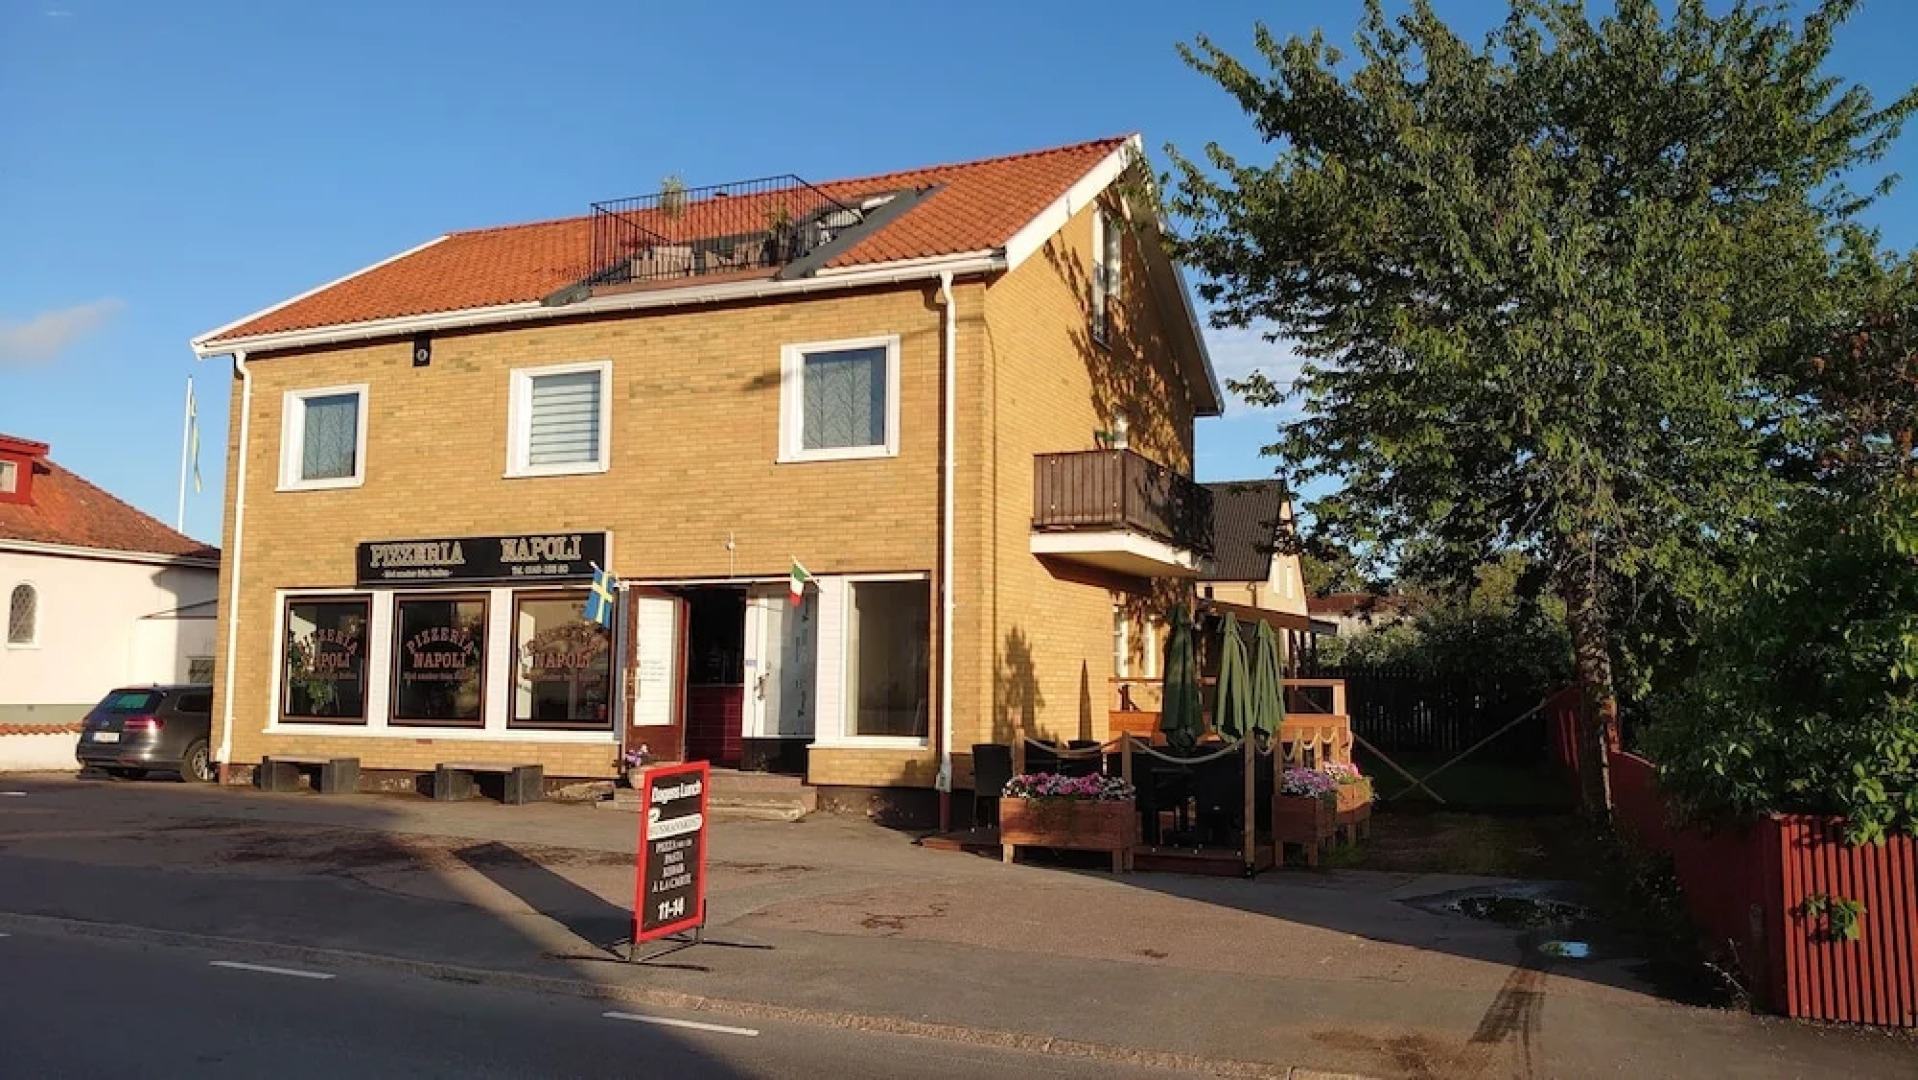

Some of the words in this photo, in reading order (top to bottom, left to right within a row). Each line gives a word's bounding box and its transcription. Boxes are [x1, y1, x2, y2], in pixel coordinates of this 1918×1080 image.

[370, 541, 464, 567] PIZZERIA
[500, 535, 582, 562] NAPOLI
[405, 626, 475, 655] PIZZERIA
[413, 651, 466, 669] NAPOLI
[533, 652, 591, 669] NAPOLI
[653, 787, 680, 804] Dagens
[681, 781, 702, 796] Lunch
[658, 898, 683, 919] 11-14
